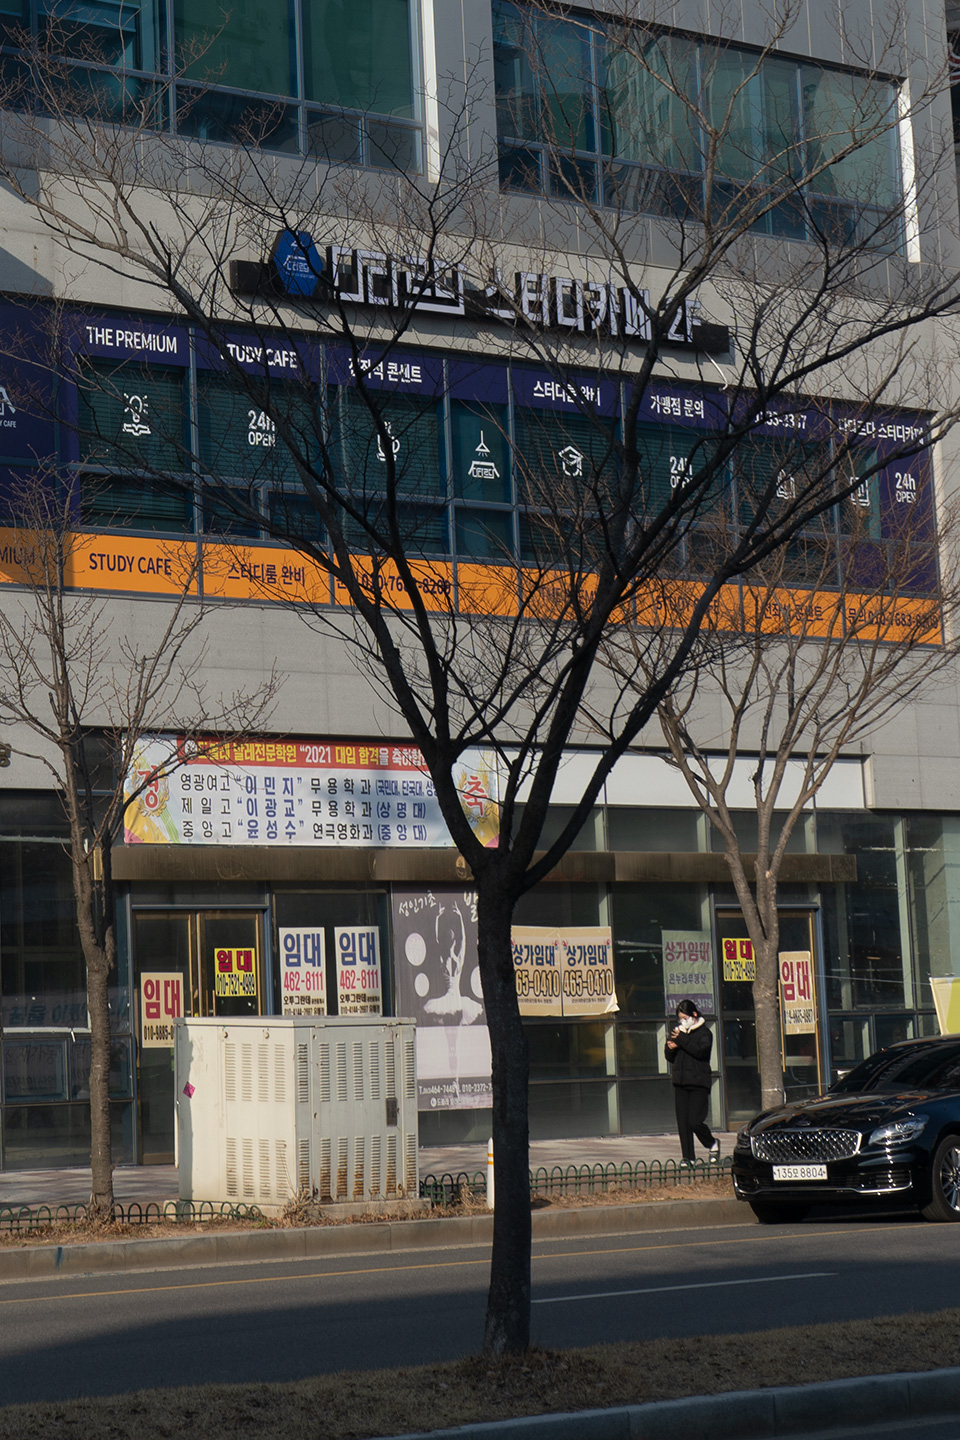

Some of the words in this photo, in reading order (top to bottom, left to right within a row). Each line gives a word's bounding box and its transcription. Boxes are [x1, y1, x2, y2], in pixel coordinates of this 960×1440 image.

[86, 326, 114, 346] THE
[116, 330, 177, 354] PREMIUM
[220, 343, 263, 363] TUDY
[266, 348, 298, 368] CAFE
[387, 362, 422, 383] 콘센트
[651, 395, 681, 417] 가맹점
[683, 399, 704, 419] 문의
[895, 472, 916, 490] 24h
[896, 490, 917, 503] OPEN
[89, 553, 135, 573] STUDY
[137, 556, 172, 576] CAFE
[228, 561, 277, 584] 스터디룸
[281, 565, 305, 587] 완비
[234, 744, 297, 763] 발레전문학원
[335, 746, 356, 765] 대입
[358, 747, 389, 766] 합격을
[181, 773, 230, 792] 영광여고
[313, 823, 373, 840] 연극영화과
[399, 890, 436, 917] 성인기초
[283, 933, 321, 967] 임대
[339, 932, 376, 966] 임대
[513, 945, 555, 966] 상가임대
[566, 945, 607, 966] 상가임대
[664, 941, 711, 962] 상가임대
[724, 940, 752, 960] 임대
[217, 950, 252, 973] 임대
[284, 971, 323, 991] 462-8111
[340, 969, 379, 990] 462-8111
[563, 968, 613, 997] 465-0410
[781, 961, 810, 1001] 임대
[144, 979, 181, 1019] 임대
[800, 1167, 823, 1178] 8804
